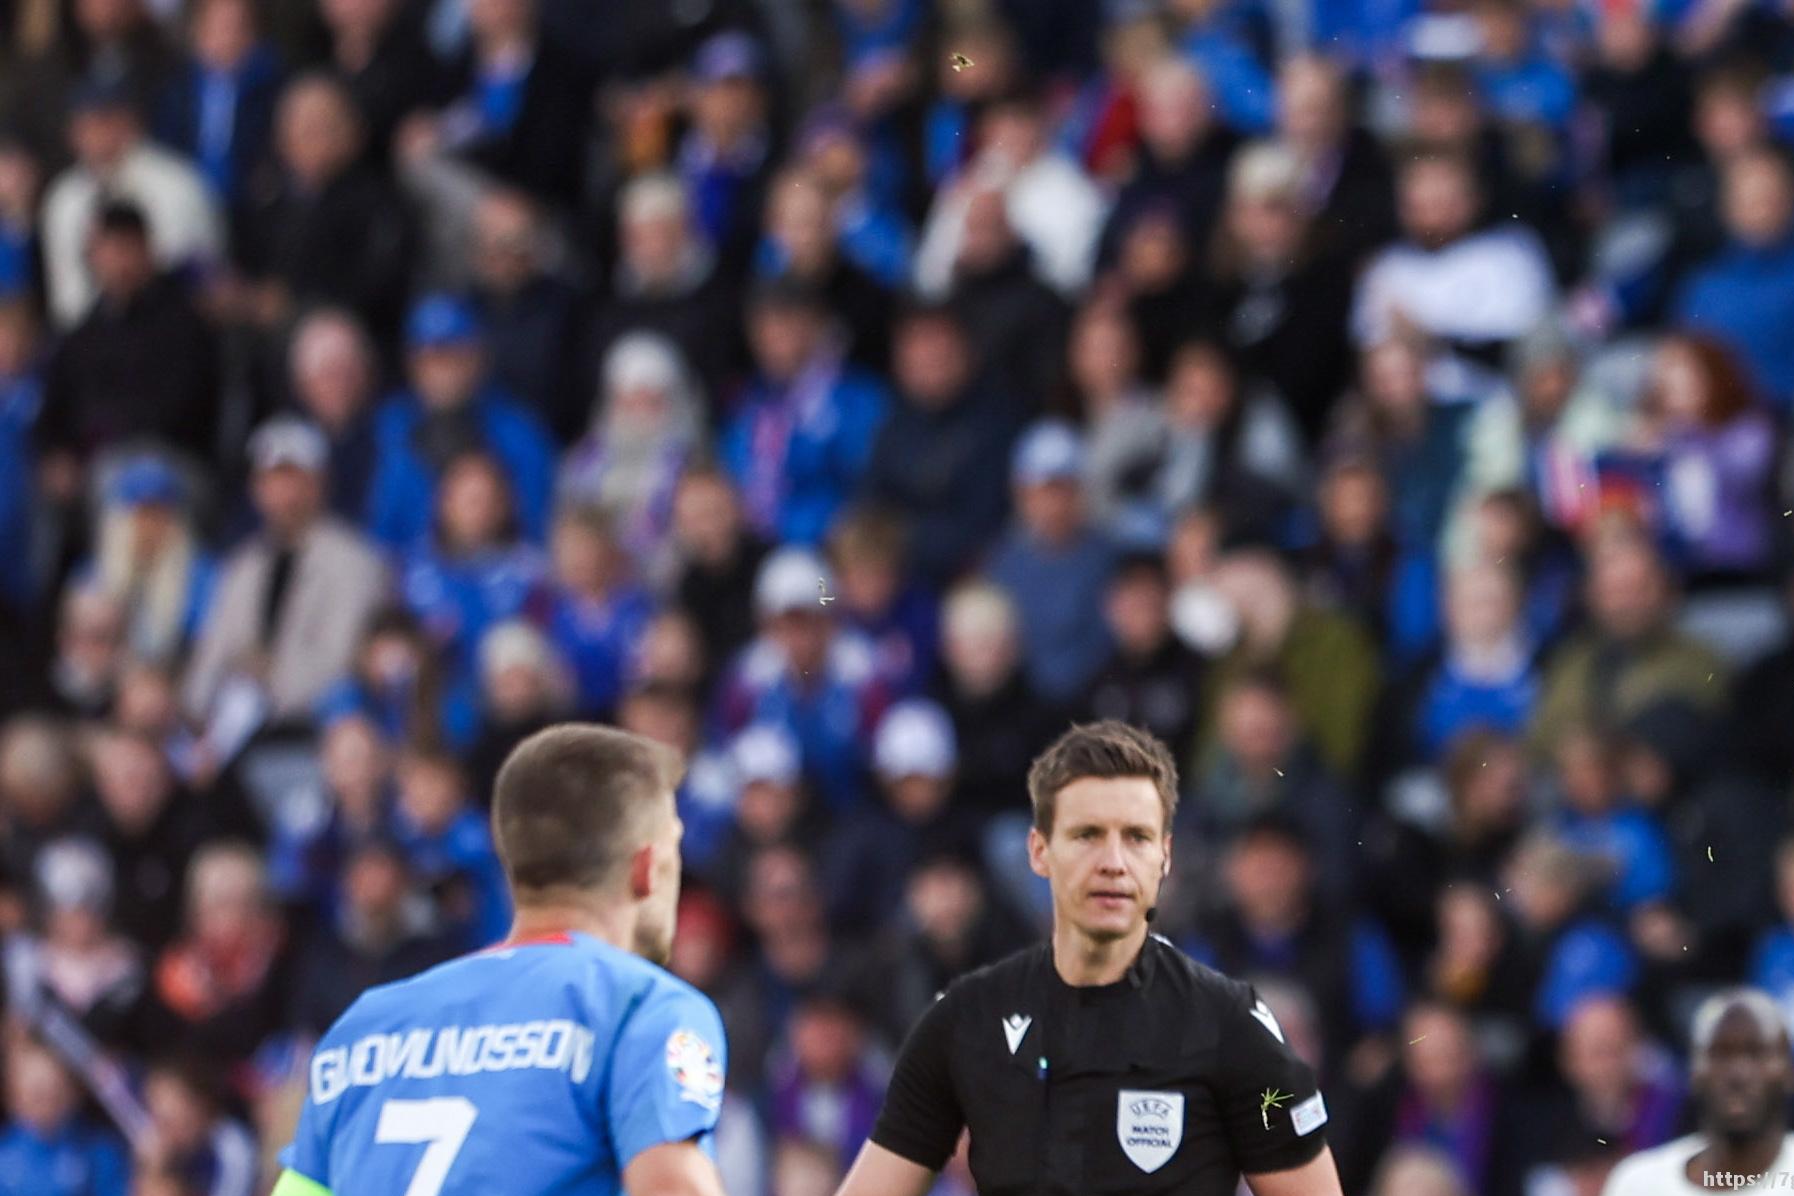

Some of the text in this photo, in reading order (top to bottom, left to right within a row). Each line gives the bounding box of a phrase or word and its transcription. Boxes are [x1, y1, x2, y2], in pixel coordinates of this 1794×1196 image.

[1129, 1099, 1170, 1118] UEFA
[1132, 1126, 1169, 1137] MATCH
[1126, 1137, 1173, 1148] OFFICIAL
